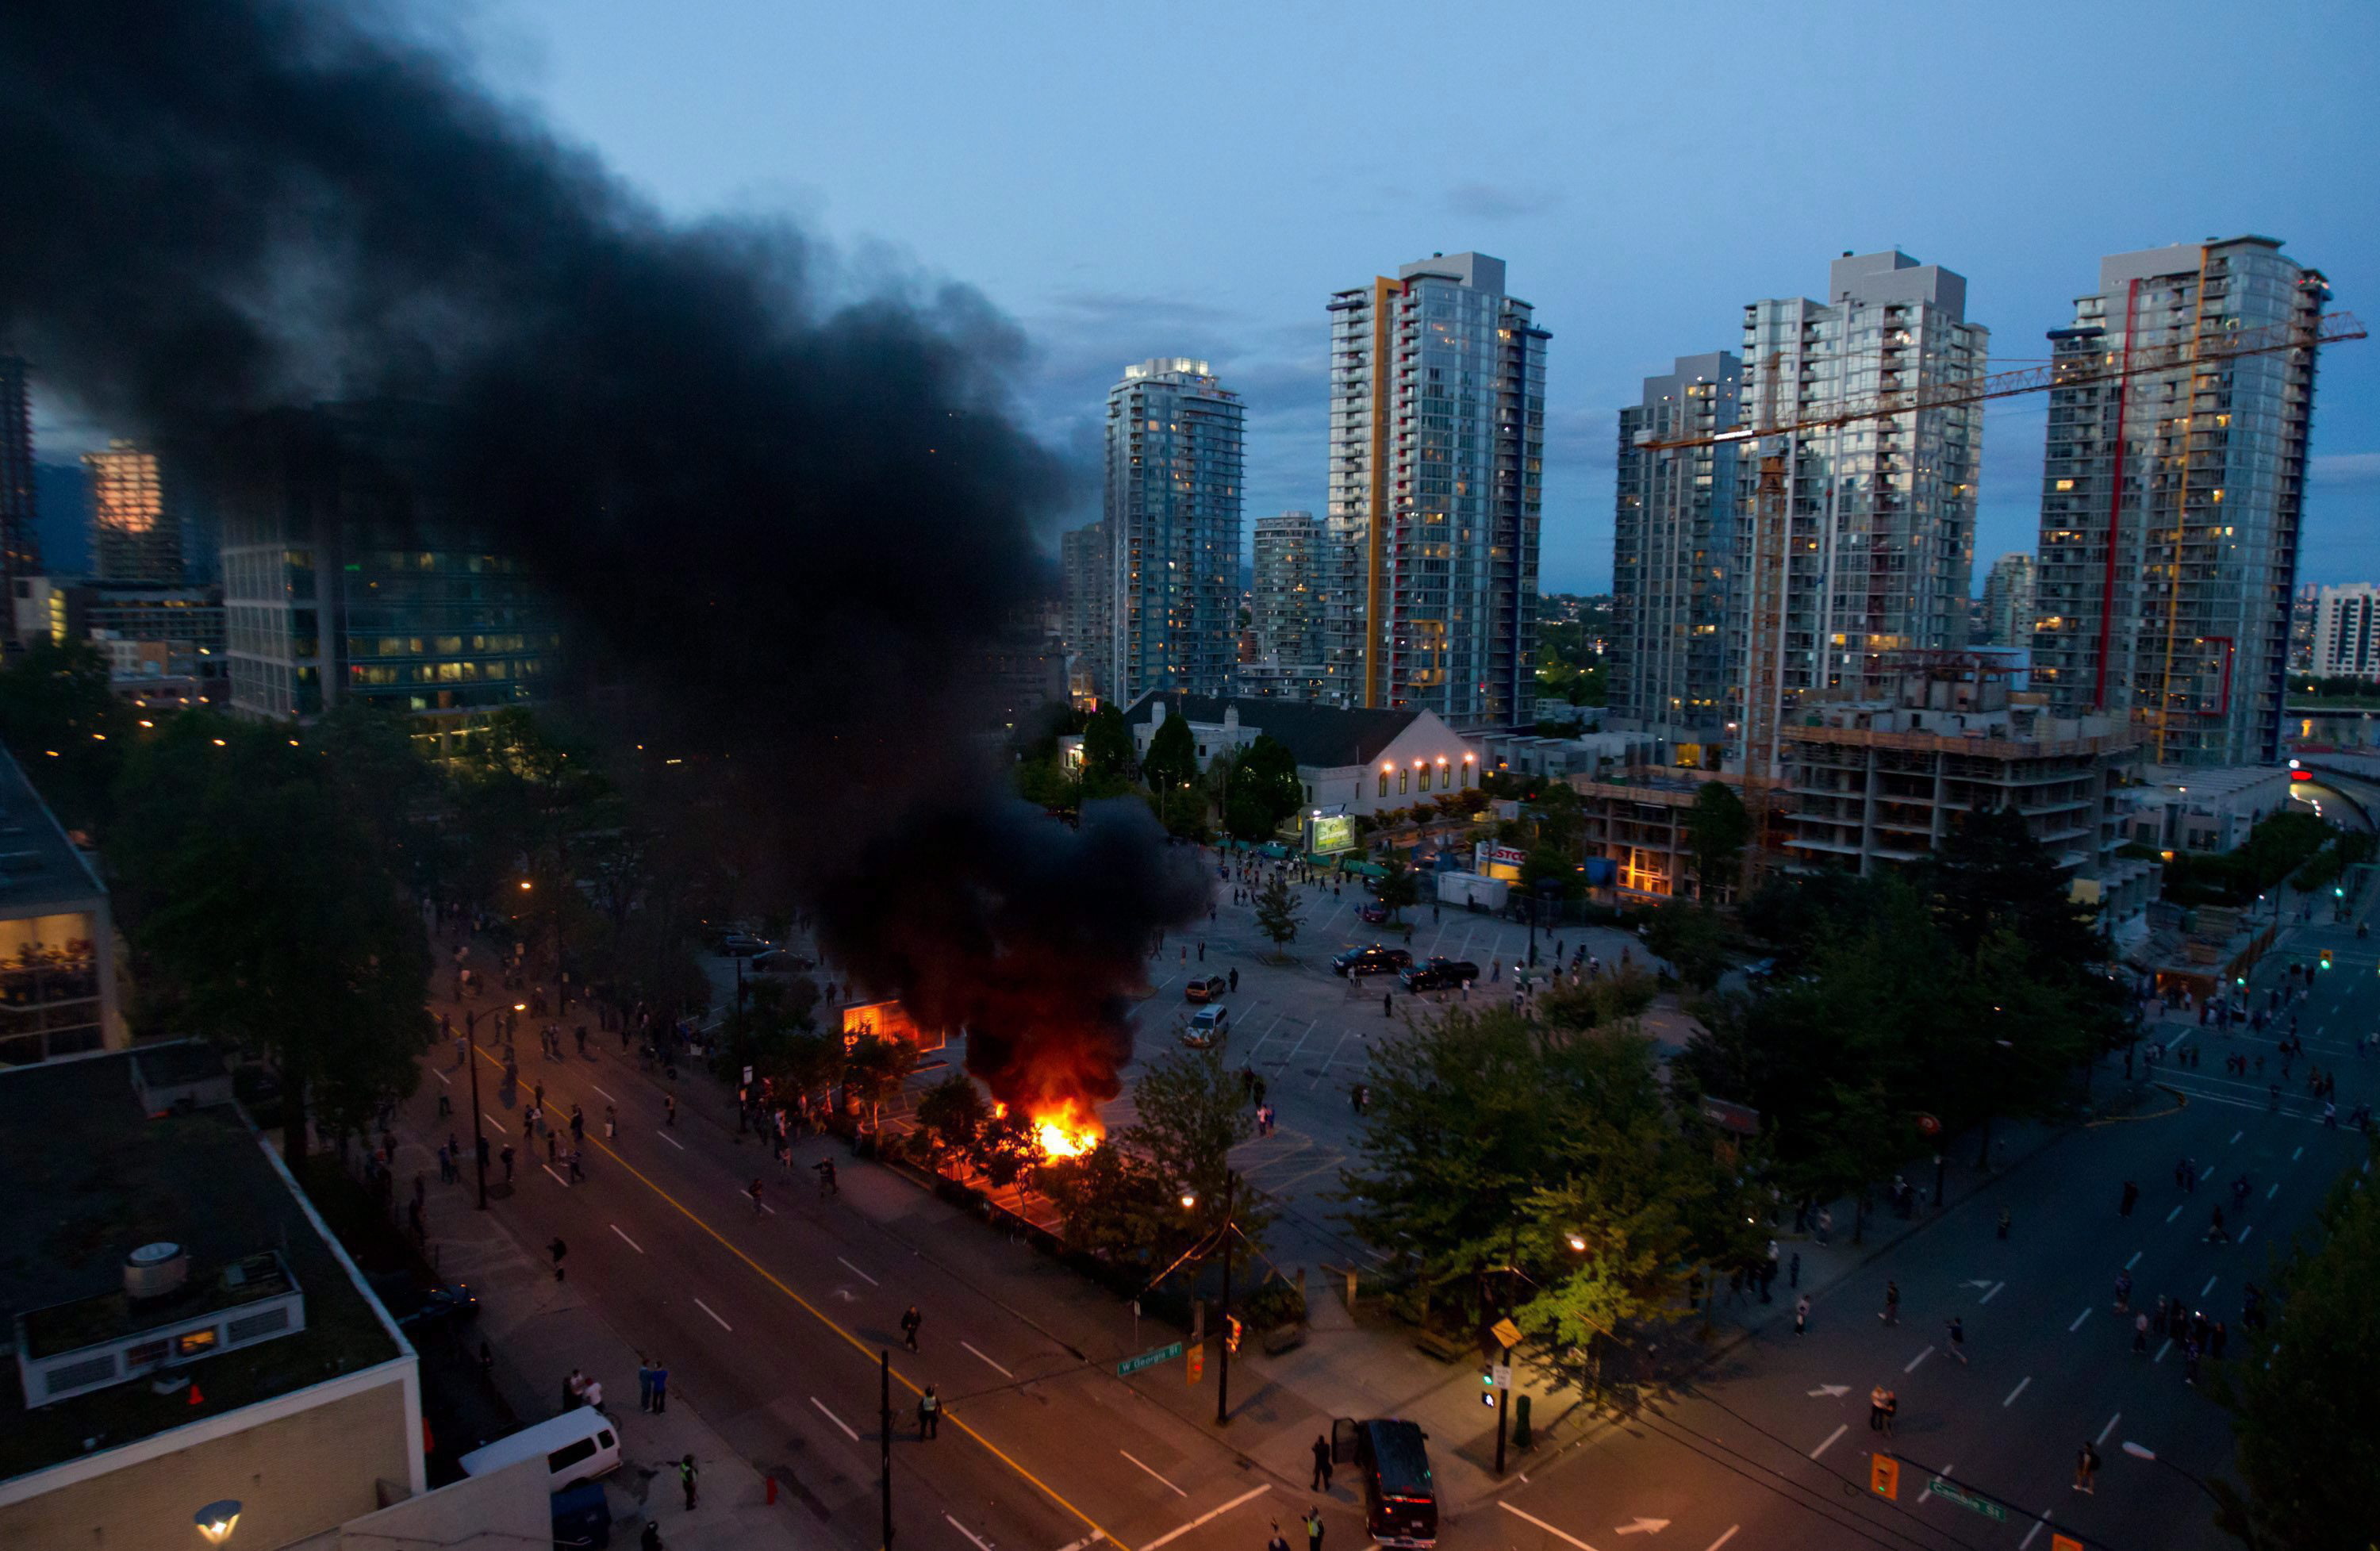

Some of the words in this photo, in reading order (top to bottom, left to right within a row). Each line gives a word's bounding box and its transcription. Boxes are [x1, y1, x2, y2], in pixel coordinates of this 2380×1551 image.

[1122, 1362, 1130, 1372] W
[1134, 1351, 1165, 1368] Georgia
[1169, 1345, 1179, 1356] St
[1933, 1483, 1980, 1509] Cambie
[1986, 1504, 2000, 1517] St
